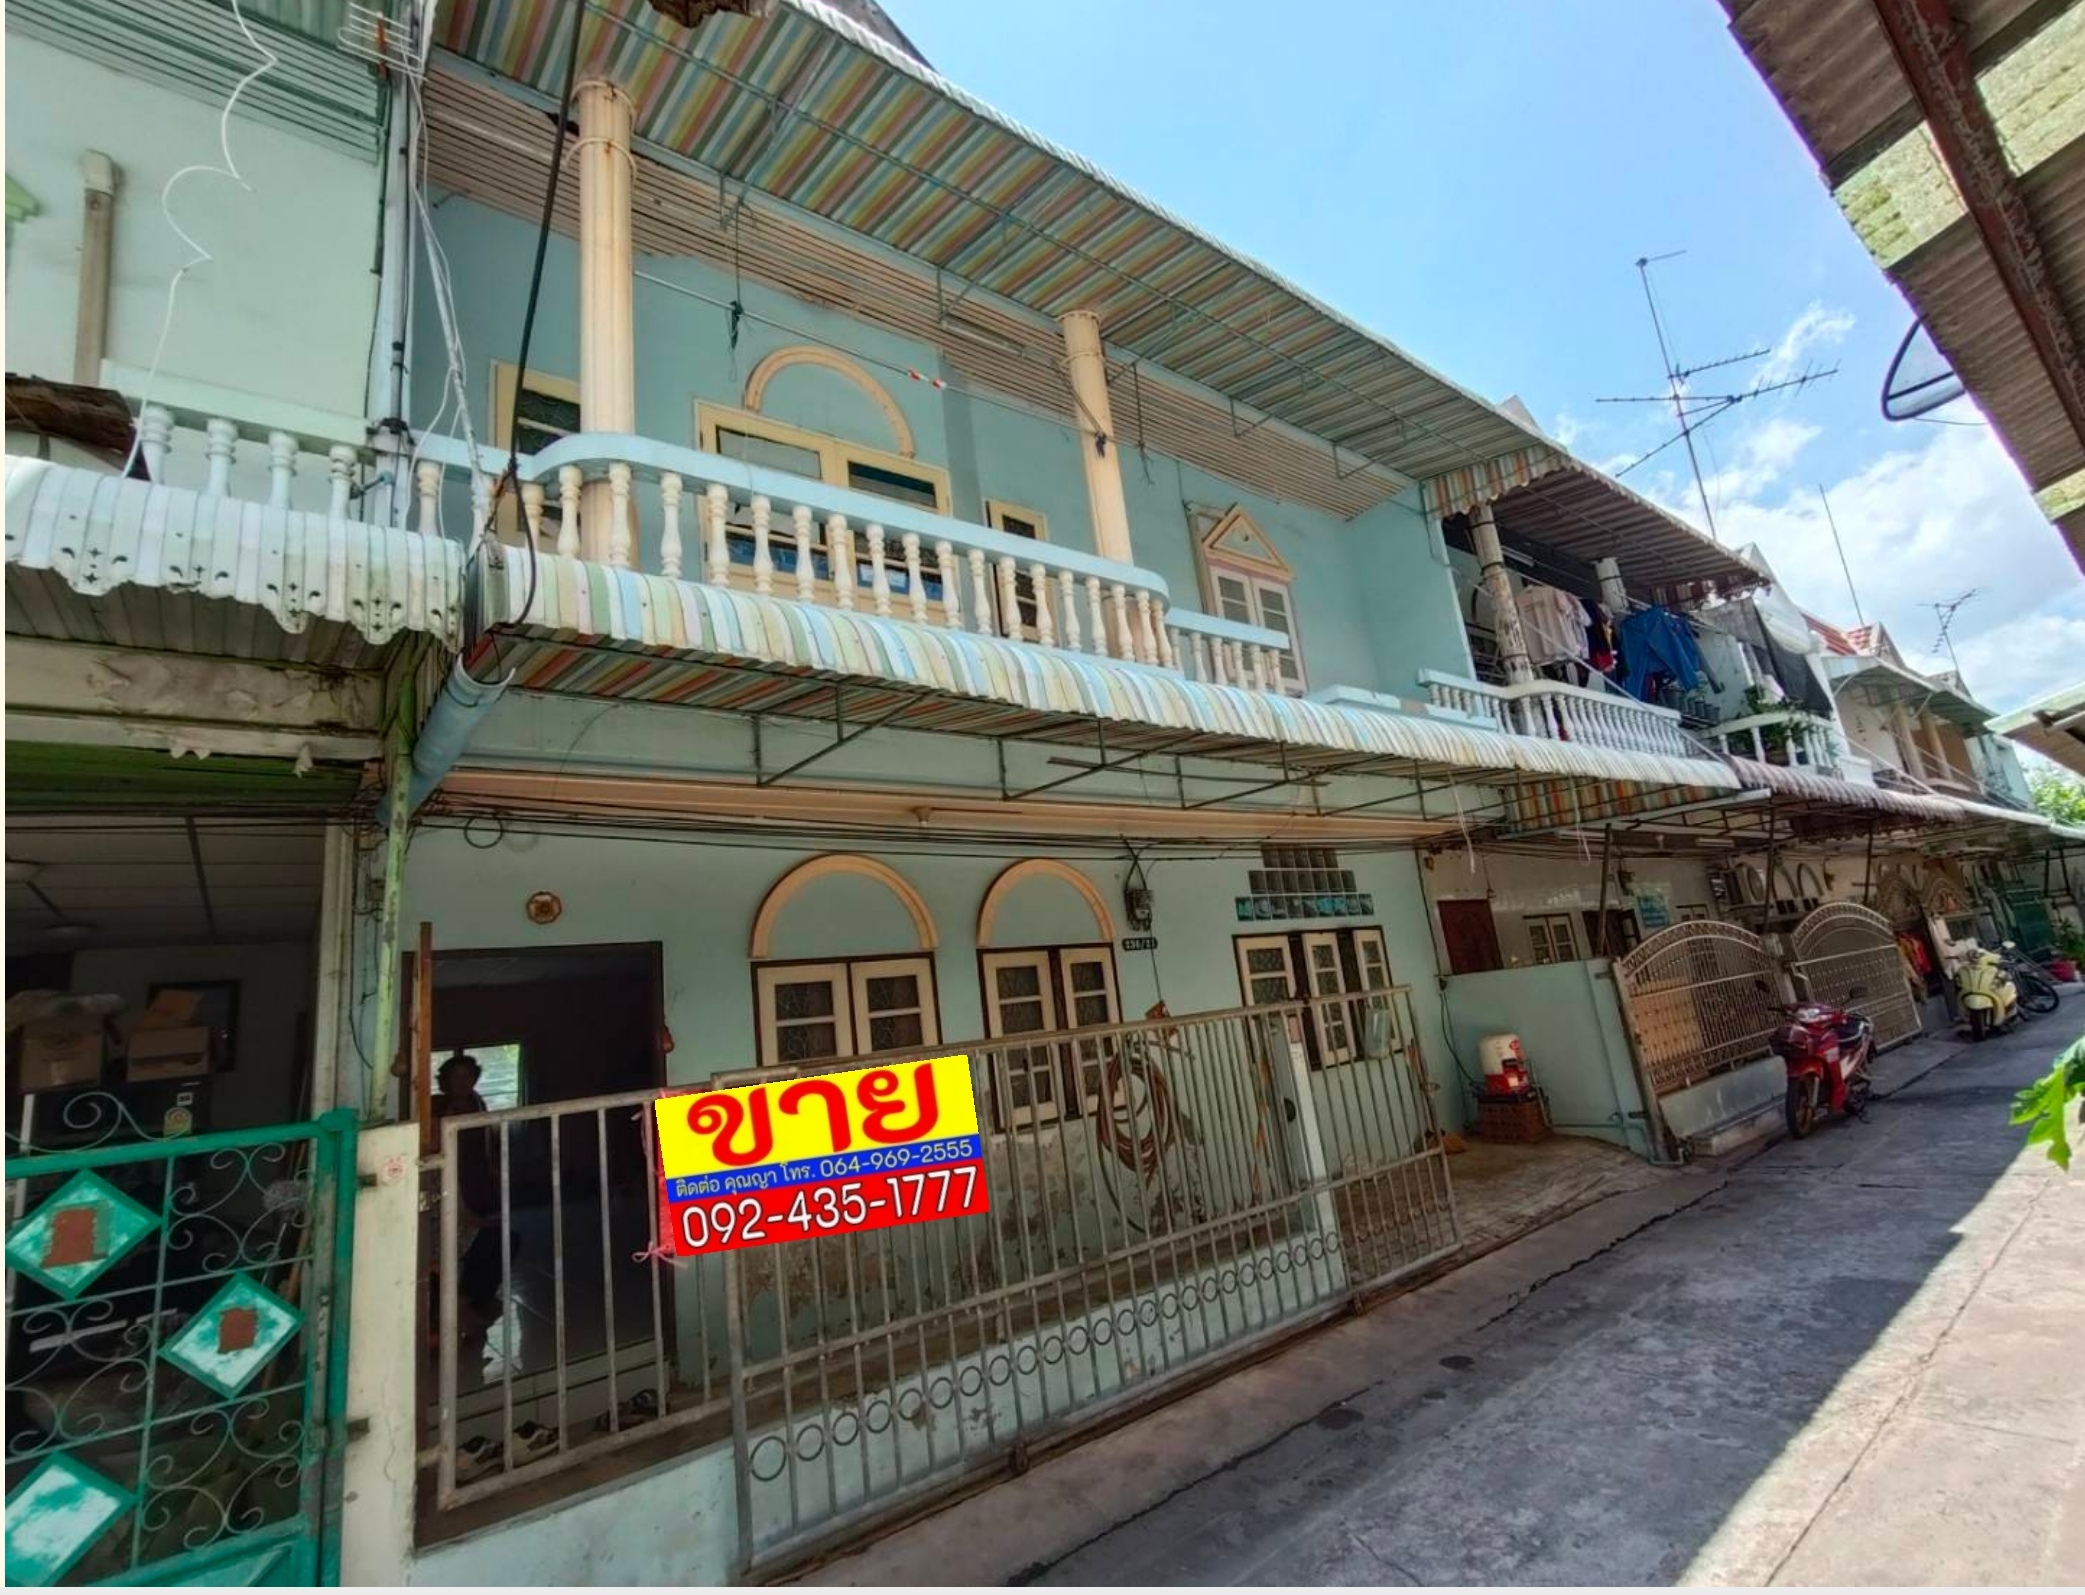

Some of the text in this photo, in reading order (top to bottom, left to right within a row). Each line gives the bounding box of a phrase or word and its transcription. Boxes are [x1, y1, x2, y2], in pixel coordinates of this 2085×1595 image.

[687, 1063, 938, 1166] ขาย
[676, 1139, 973, 1197] ติดต่อ คุณญา โทร. 064-969-2555
[682, 1166, 977, 1247] 092-435-1777
